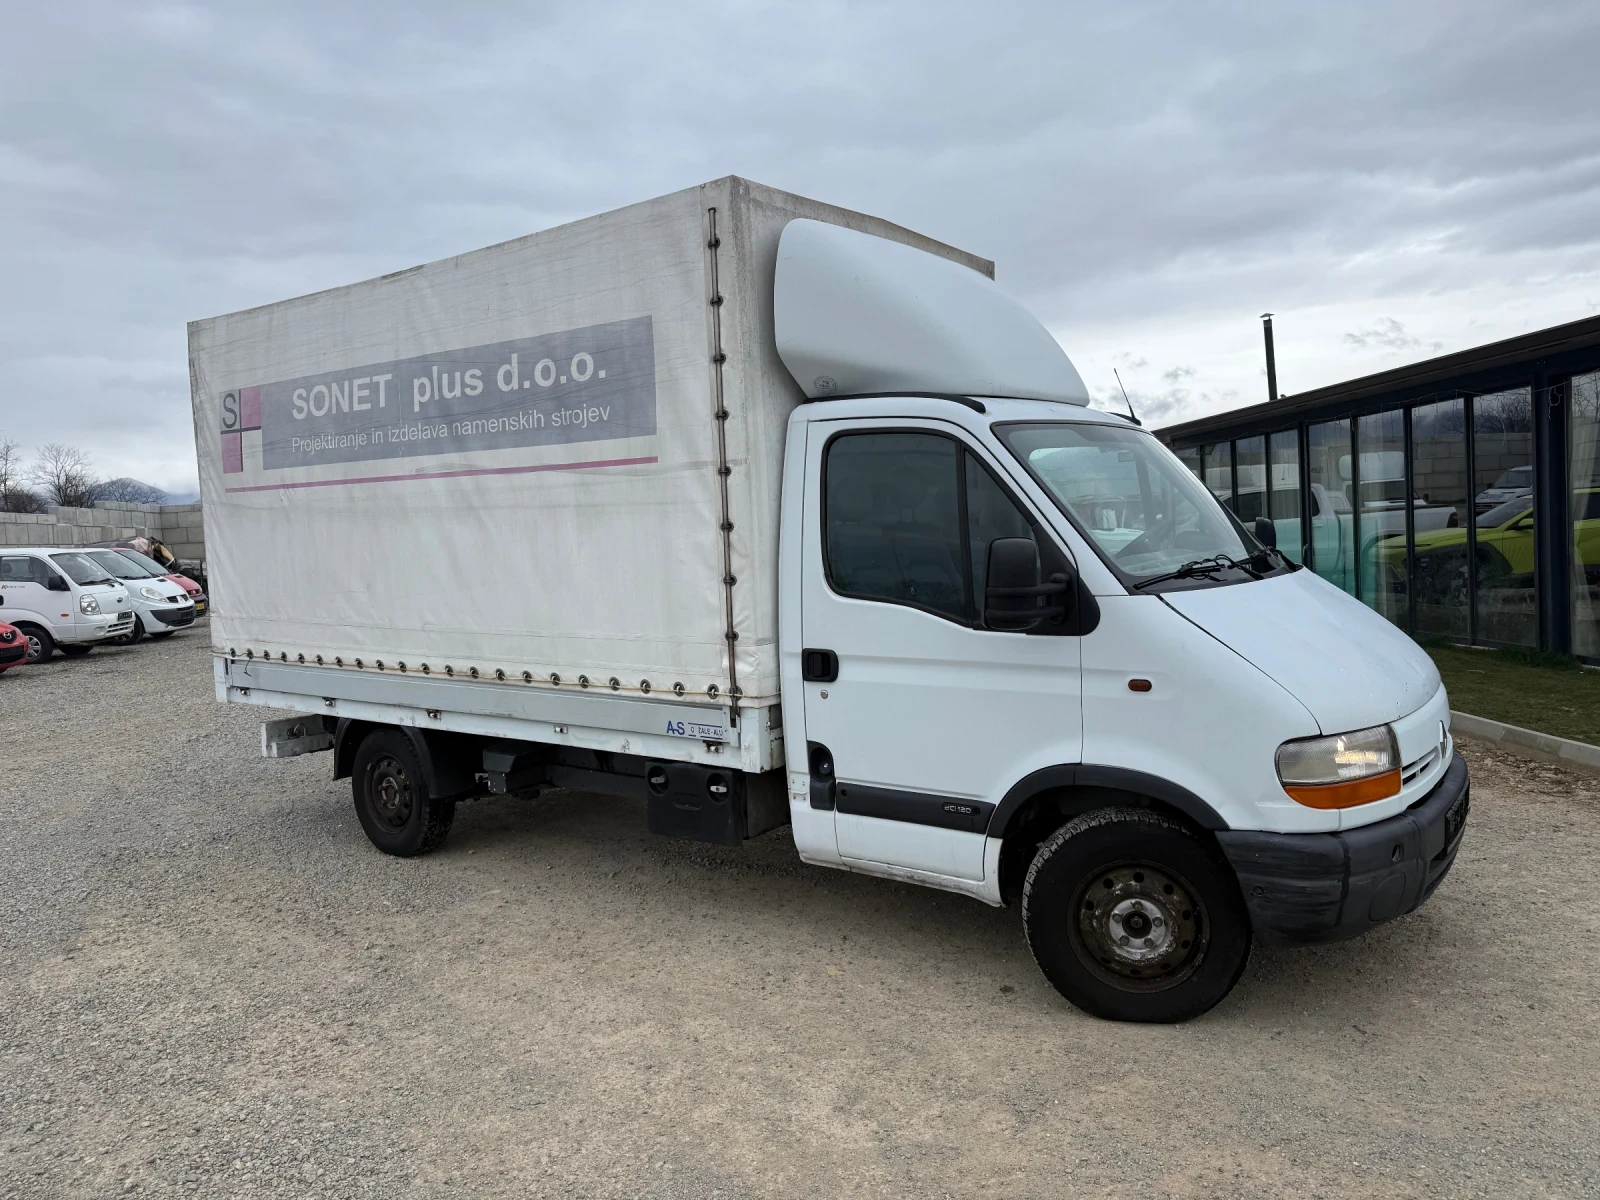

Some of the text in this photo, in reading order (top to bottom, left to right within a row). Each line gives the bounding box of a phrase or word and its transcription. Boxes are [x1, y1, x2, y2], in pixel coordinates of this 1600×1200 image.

[291, 352, 606, 420] SONET plus d.o.o.
[292, 403, 611, 455] Projektiranje in izdelava namenskih strojev
